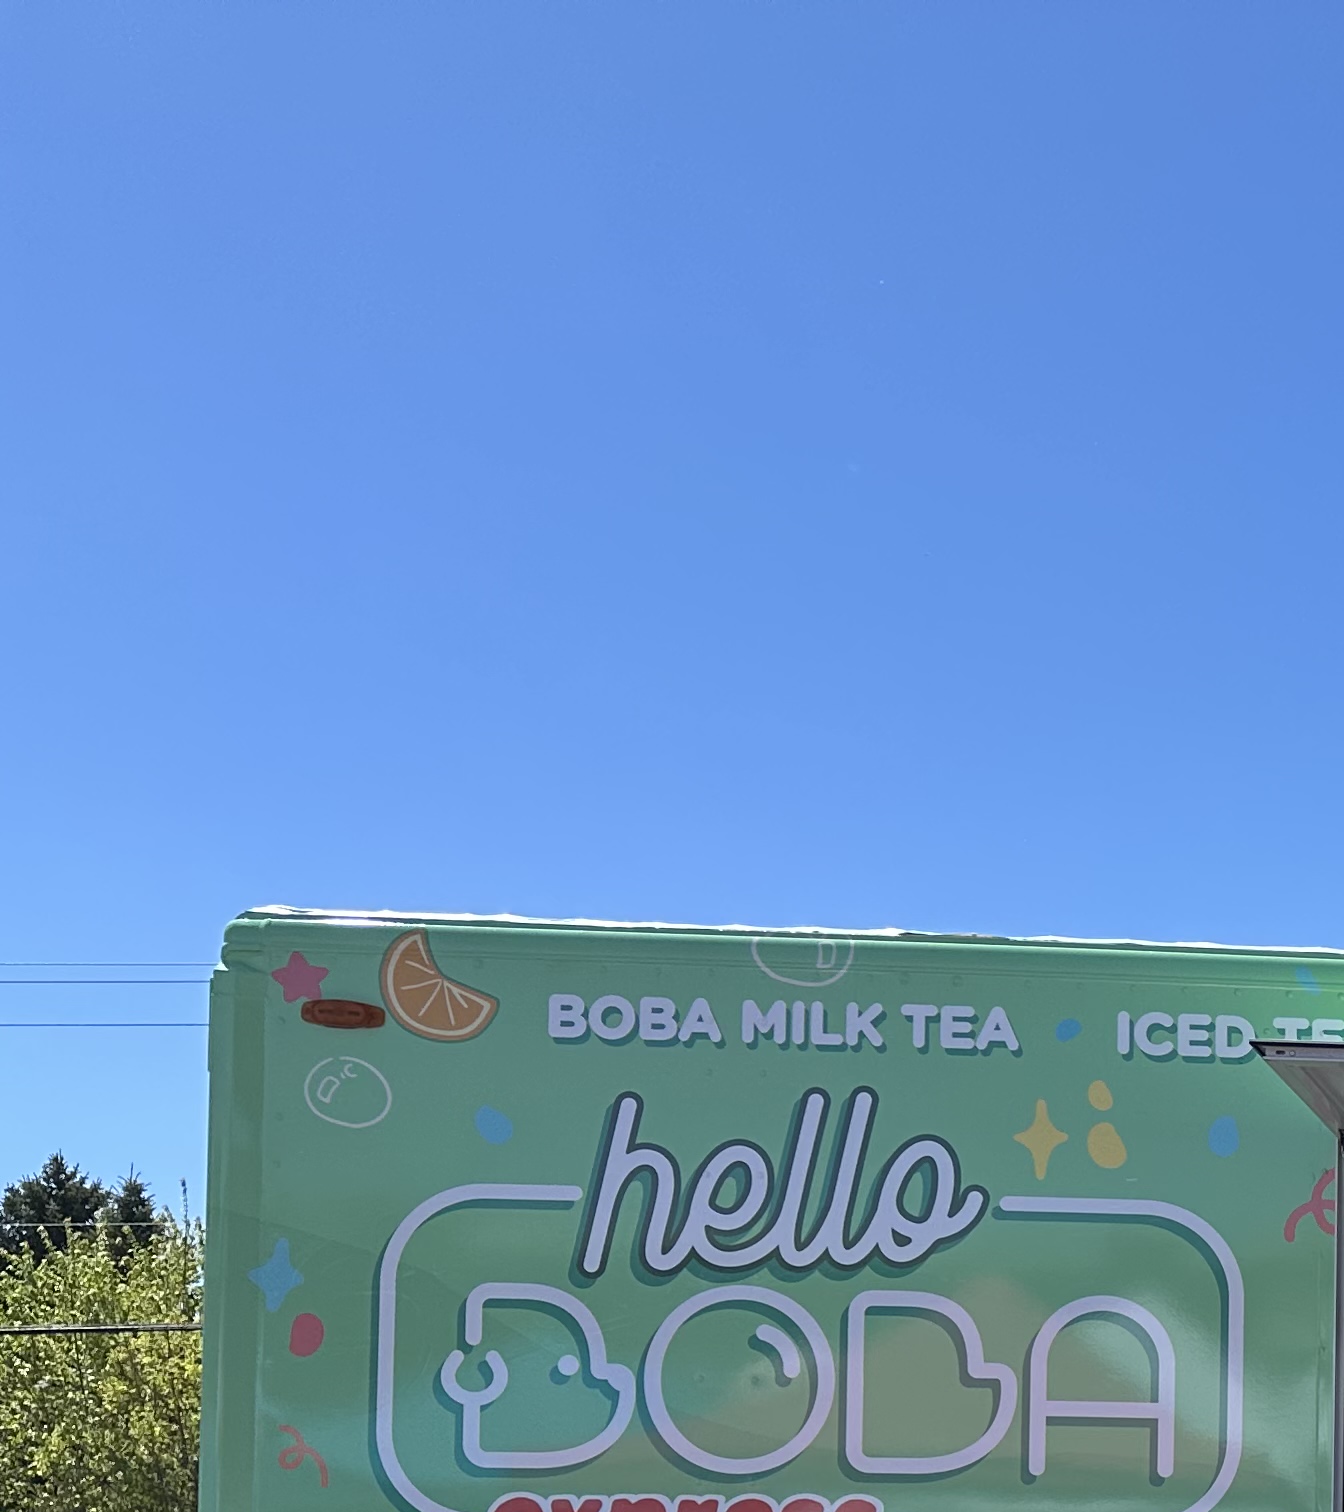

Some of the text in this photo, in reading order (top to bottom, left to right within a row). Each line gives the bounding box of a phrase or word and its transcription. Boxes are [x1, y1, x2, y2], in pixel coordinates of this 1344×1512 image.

[548, 993, 1020, 1051] BOBA MILK TEA
[1117, 1010, 1256, 1059] ICED
[576, 1086, 988, 1274] hello
[441, 1283, 1175, 1477] BOBA
